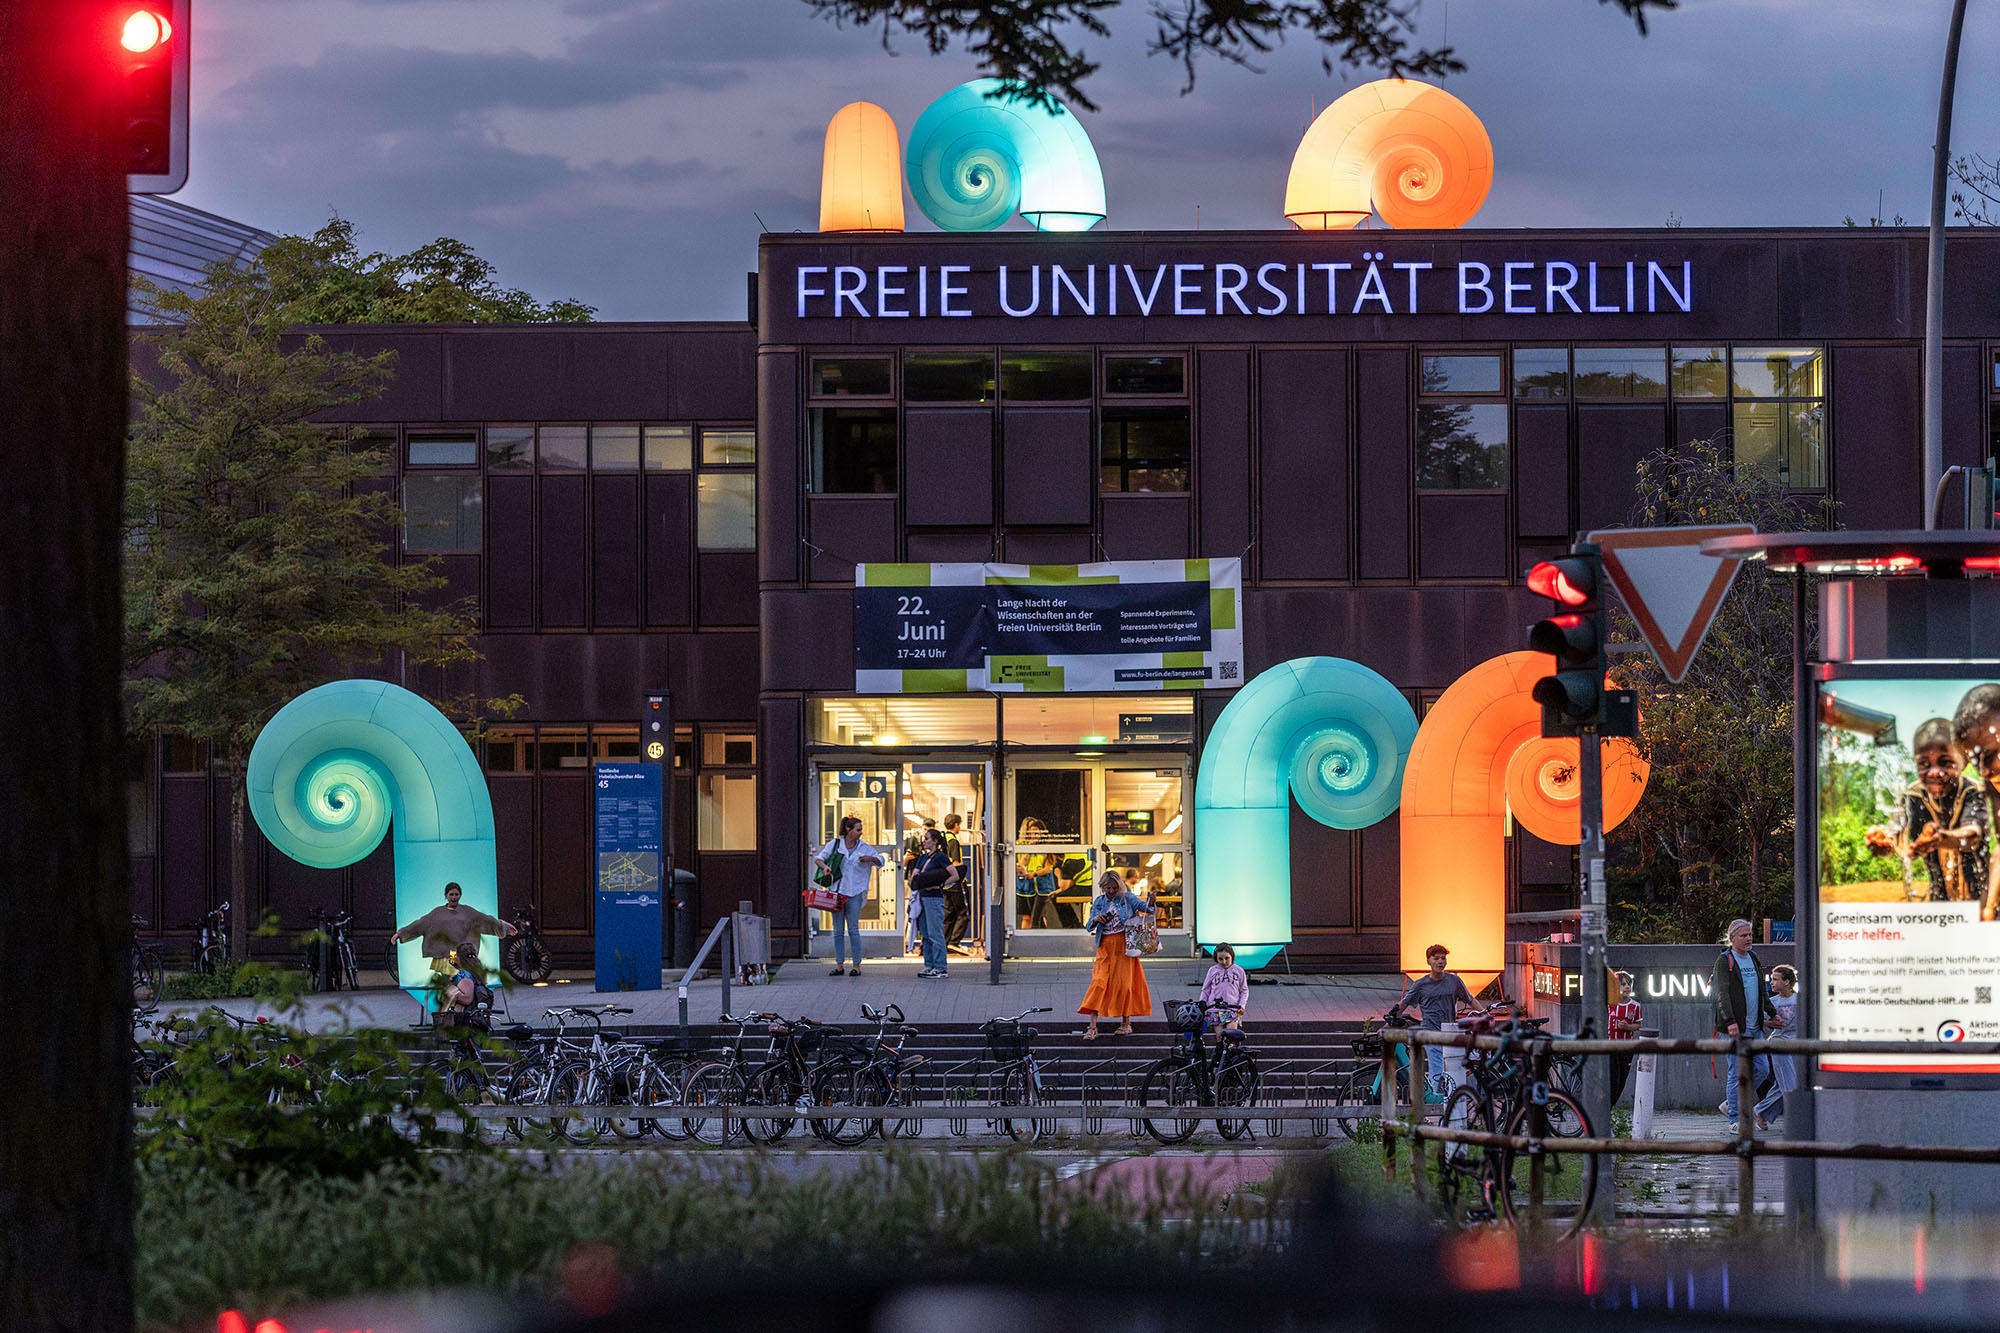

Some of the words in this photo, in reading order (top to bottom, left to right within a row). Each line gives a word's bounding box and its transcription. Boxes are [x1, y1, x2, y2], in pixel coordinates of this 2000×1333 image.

[797, 265, 973, 318] FREIE
[999, 251, 1433, 318] UNIVERSITÄT
[1457, 261, 1693, 315] BERLIN
[897, 596, 931, 615] 22.
[997, 599, 1023, 610] Lange
[1025, 599, 1051, 608] Nacht
[1052, 598, 1068, 608] der
[997, 611, 1064, 620] Wissenschaften
[1065, 612, 1077, 620] an
[1078, 610, 1094, 620] der
[1120, 611, 1155, 619] Spannende
[1155, 610, 1196, 619] Experimente,
[897, 620, 946, 641] Juni
[997, 623, 1025, 632] Freien
[1026, 622, 1074, 632] Universität
[1075, 622, 1102, 632] Berlin
[1159, 622, 1185, 631] Vorträge
[1135, 636, 1164, 645] Angebote
[928, 648, 947, 658] Uhr
[598, 780, 609, 789] 45
[1826, 911, 1892, 925] Gemeinsam
[1896, 914, 1969, 927] vorsorgen.
[1827, 928, 1859, 941] Besser
[1861, 928, 1905, 941] helfen.
[1896, 956, 1915, 964] Hilft
[1916, 956, 1943, 964] leistet
[1945, 956, 1981, 964] Nothilfe
[1873, 968, 1887, 976] und
[1889, 968, 1907, 976] hilft
[1949, 968, 1966, 976] sich
[1968, 968, 1995, 976] besser
[1211, 972, 1240, 986] GAP
[1969, 1021, 1999, 1029] Aktion
[1969, 1031, 2000, 1039] Deutsc
